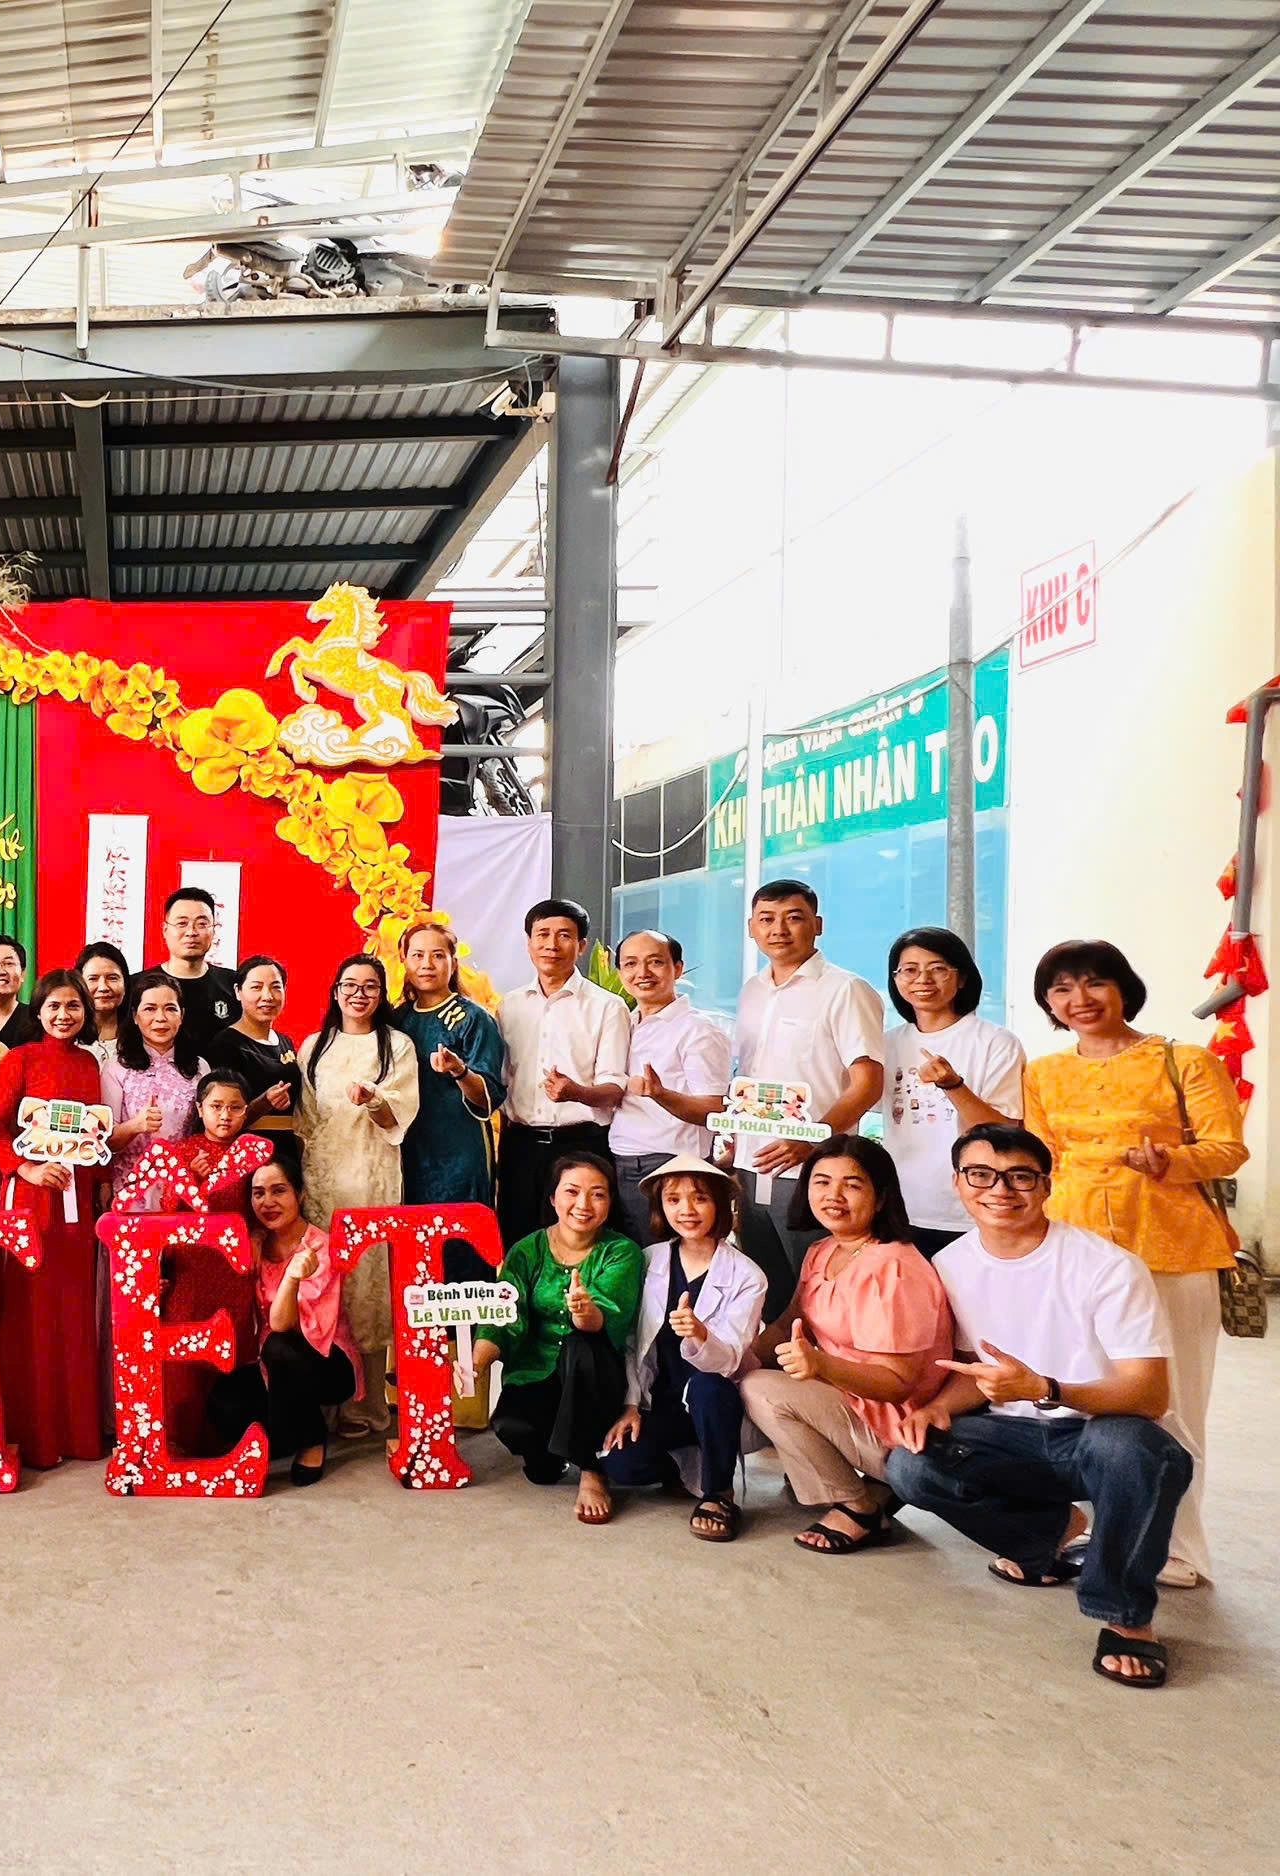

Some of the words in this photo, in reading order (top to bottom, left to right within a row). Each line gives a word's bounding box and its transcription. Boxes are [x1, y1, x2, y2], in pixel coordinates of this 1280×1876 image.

[1026, 571, 1068, 647] KHU
[1077, 563, 1089, 625] C
[762, 765, 825, 846] THẬN
[833, 736, 915, 820] NHÂN
[926, 715, 998, 794] TO
[738, 1119, 772, 1134] KHAI
[30, 1139, 95, 1160] 2026
[427, 1289, 460, 1303] Bệnh
[464, 1286, 494, 1301] Viện
[439, 1306, 471, 1321] Văn
